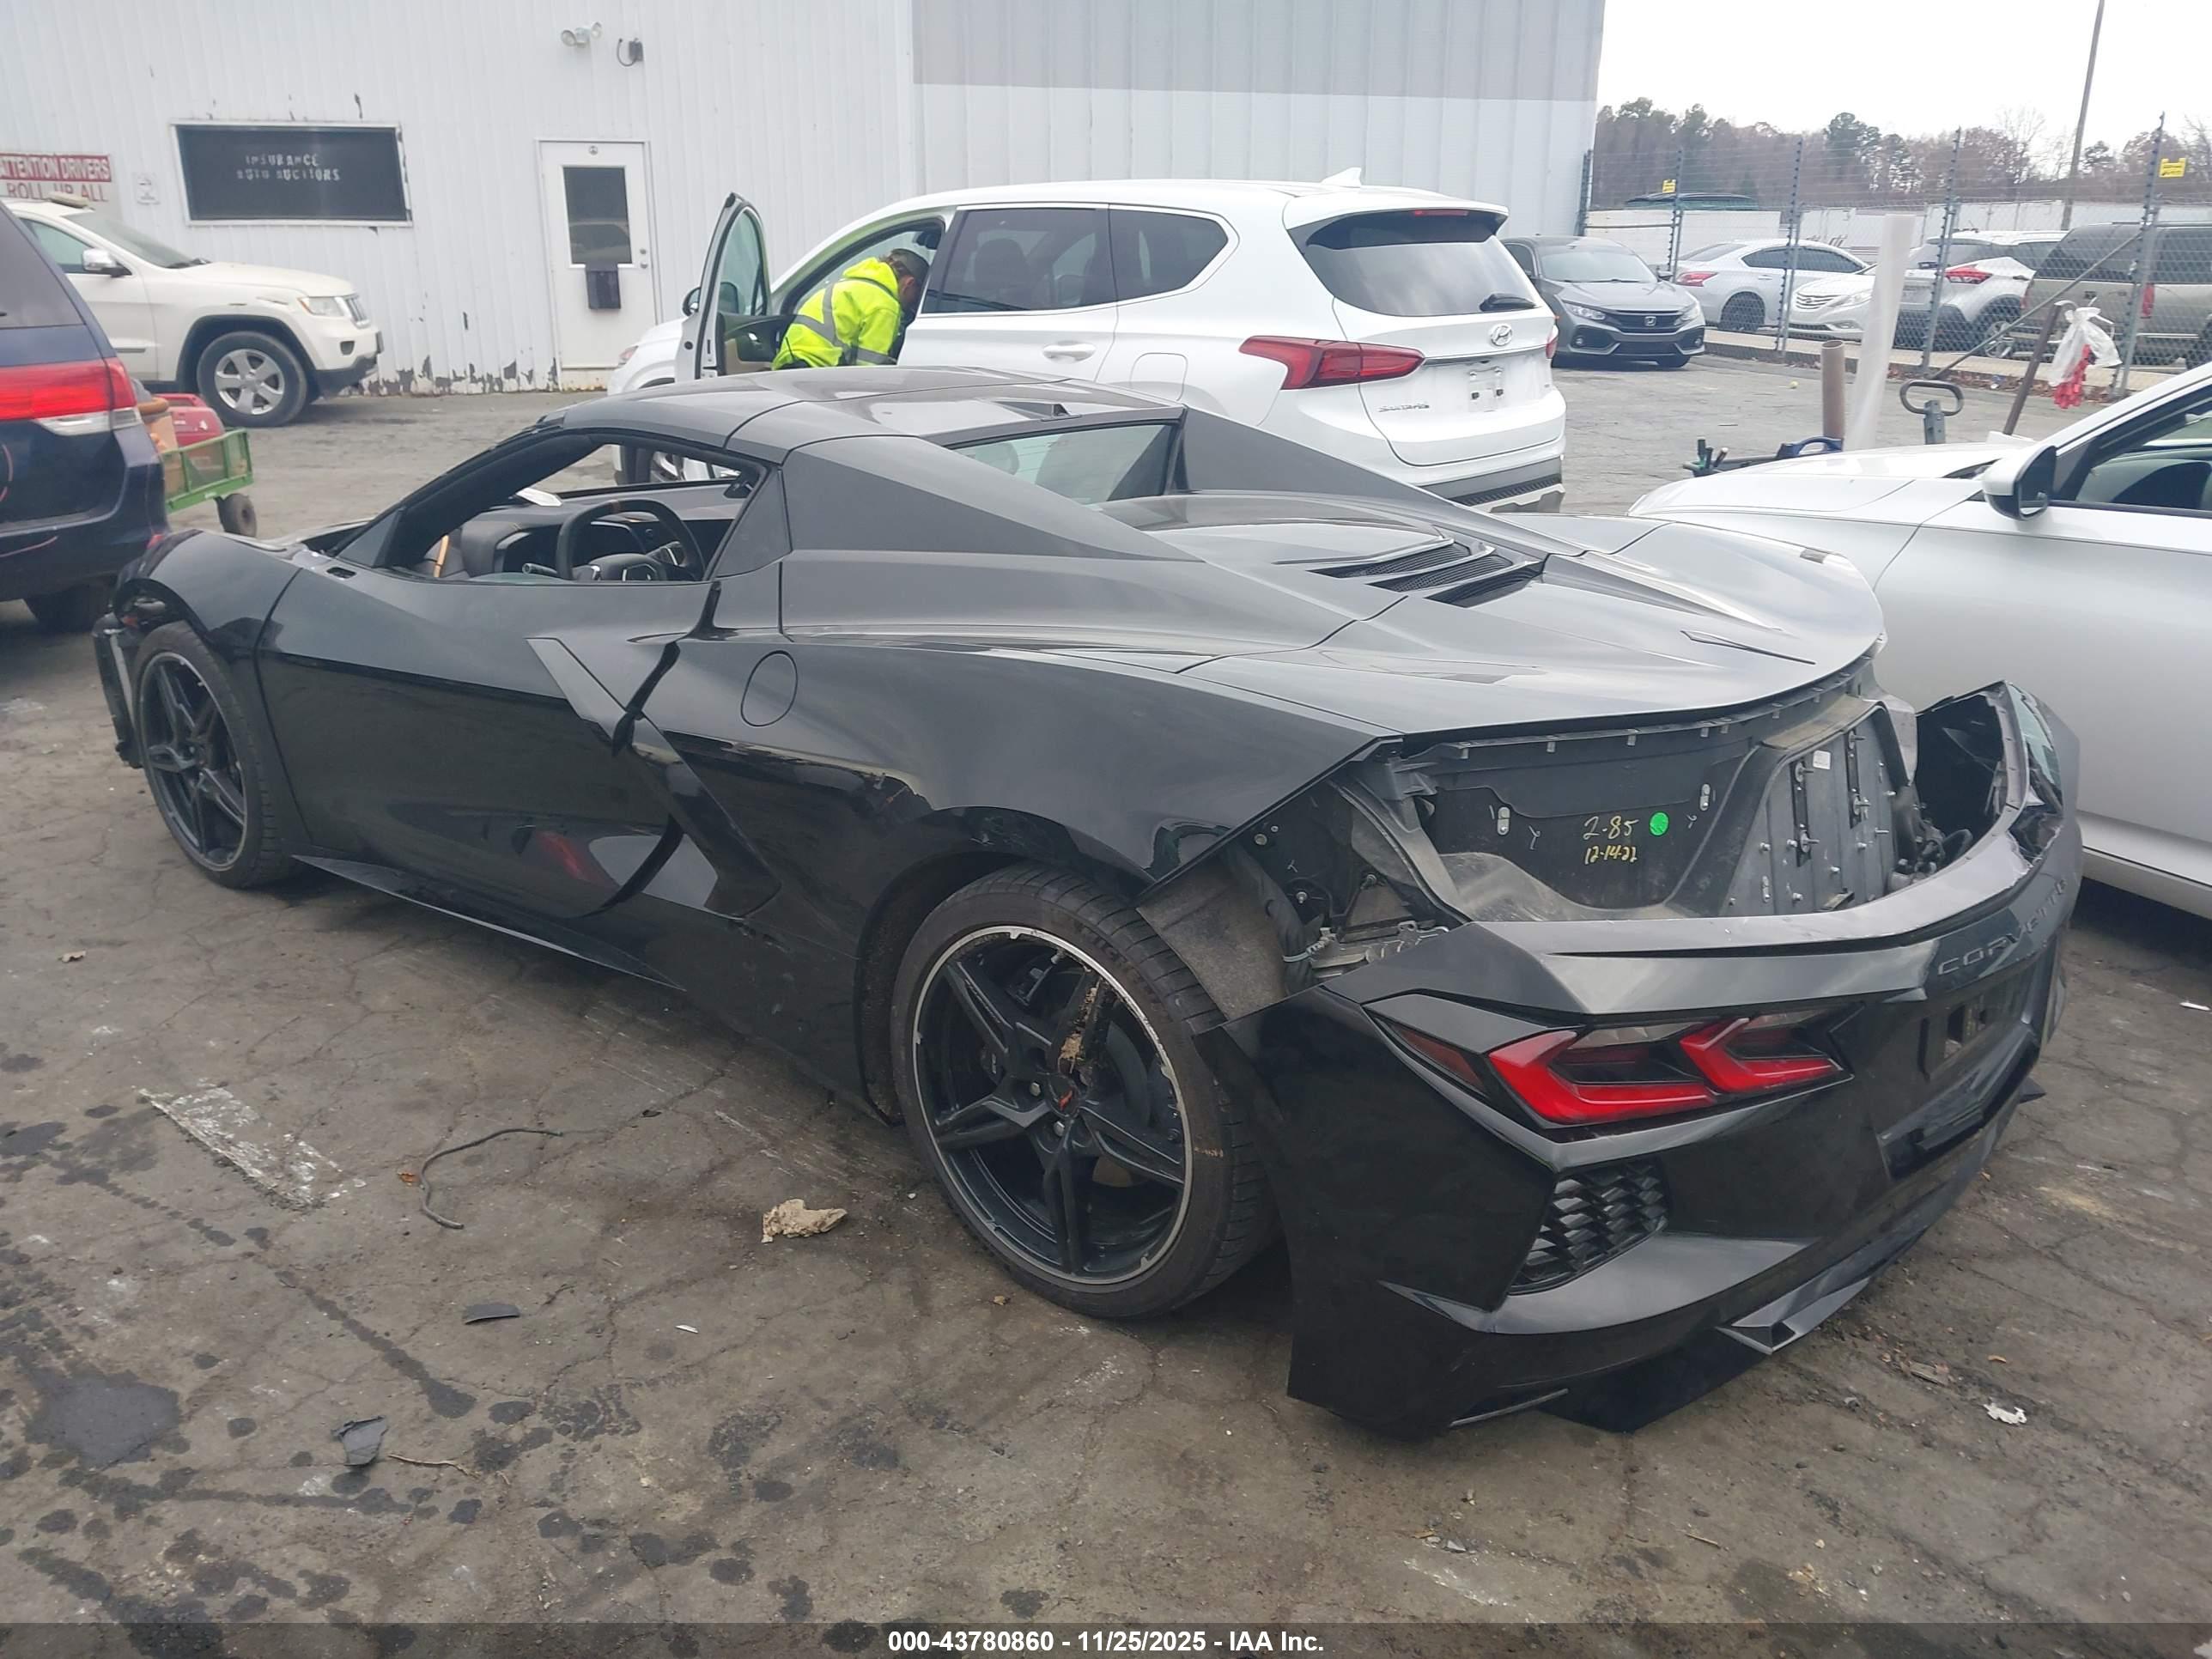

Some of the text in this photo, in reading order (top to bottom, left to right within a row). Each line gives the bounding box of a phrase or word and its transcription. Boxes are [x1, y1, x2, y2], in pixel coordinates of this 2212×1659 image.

[59, 157, 110, 179] DRIVERS
[246, 154, 318, 167] INSURANCE
[7, 181, 43, 200] ROLL
[81, 183, 109, 202] ALL
[1583, 815, 1640, 841] 2-85
